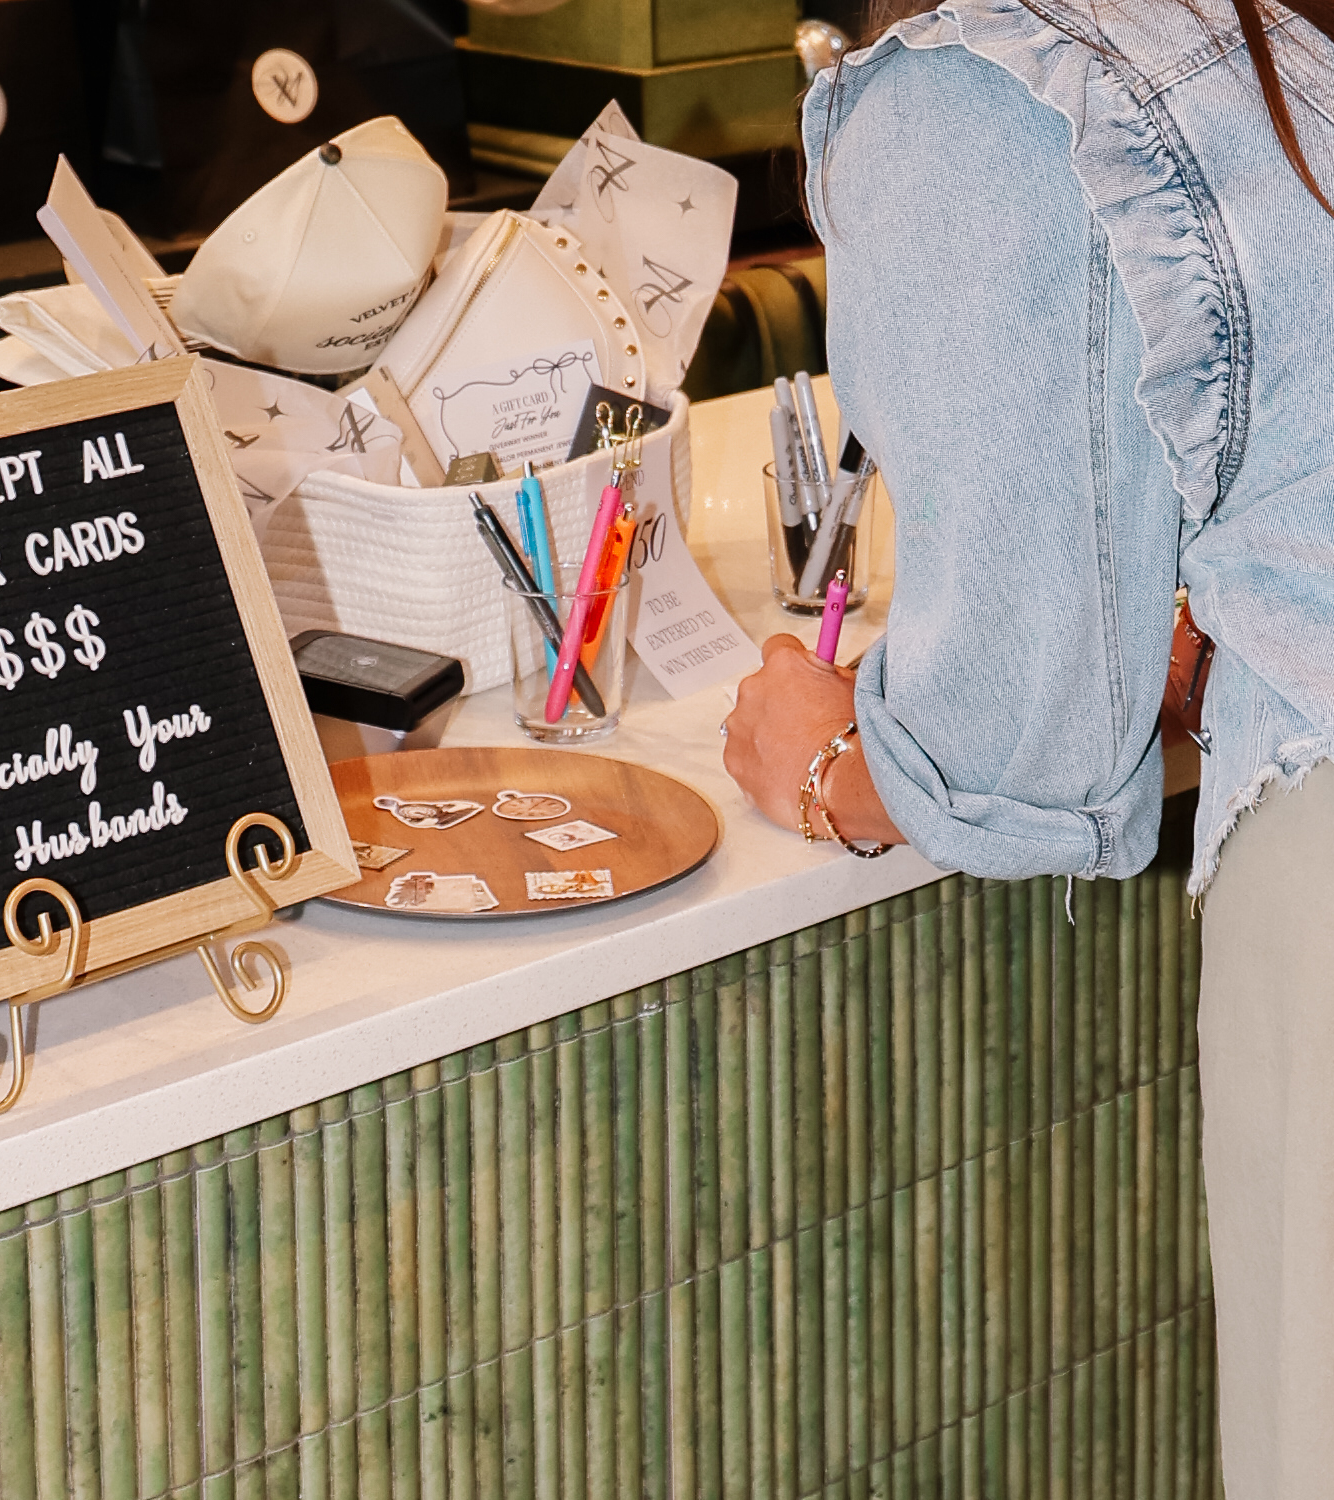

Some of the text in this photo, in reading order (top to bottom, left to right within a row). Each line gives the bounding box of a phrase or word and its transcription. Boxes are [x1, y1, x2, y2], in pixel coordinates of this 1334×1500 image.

[499, 398, 521, 414] GIFT
[522, 391, 549, 409] CARD
[81, 432, 145, 484] ALL
[24, 511, 146, 577] CARDS
[645, 591, 681, 617] TO BE
[645, 610, 716, 651] ENTERED TO
[659, 633, 740, 677] WIN THIS BOX!
[122, 702, 212, 773] Your
[13, 780, 189, 873] Husbands
